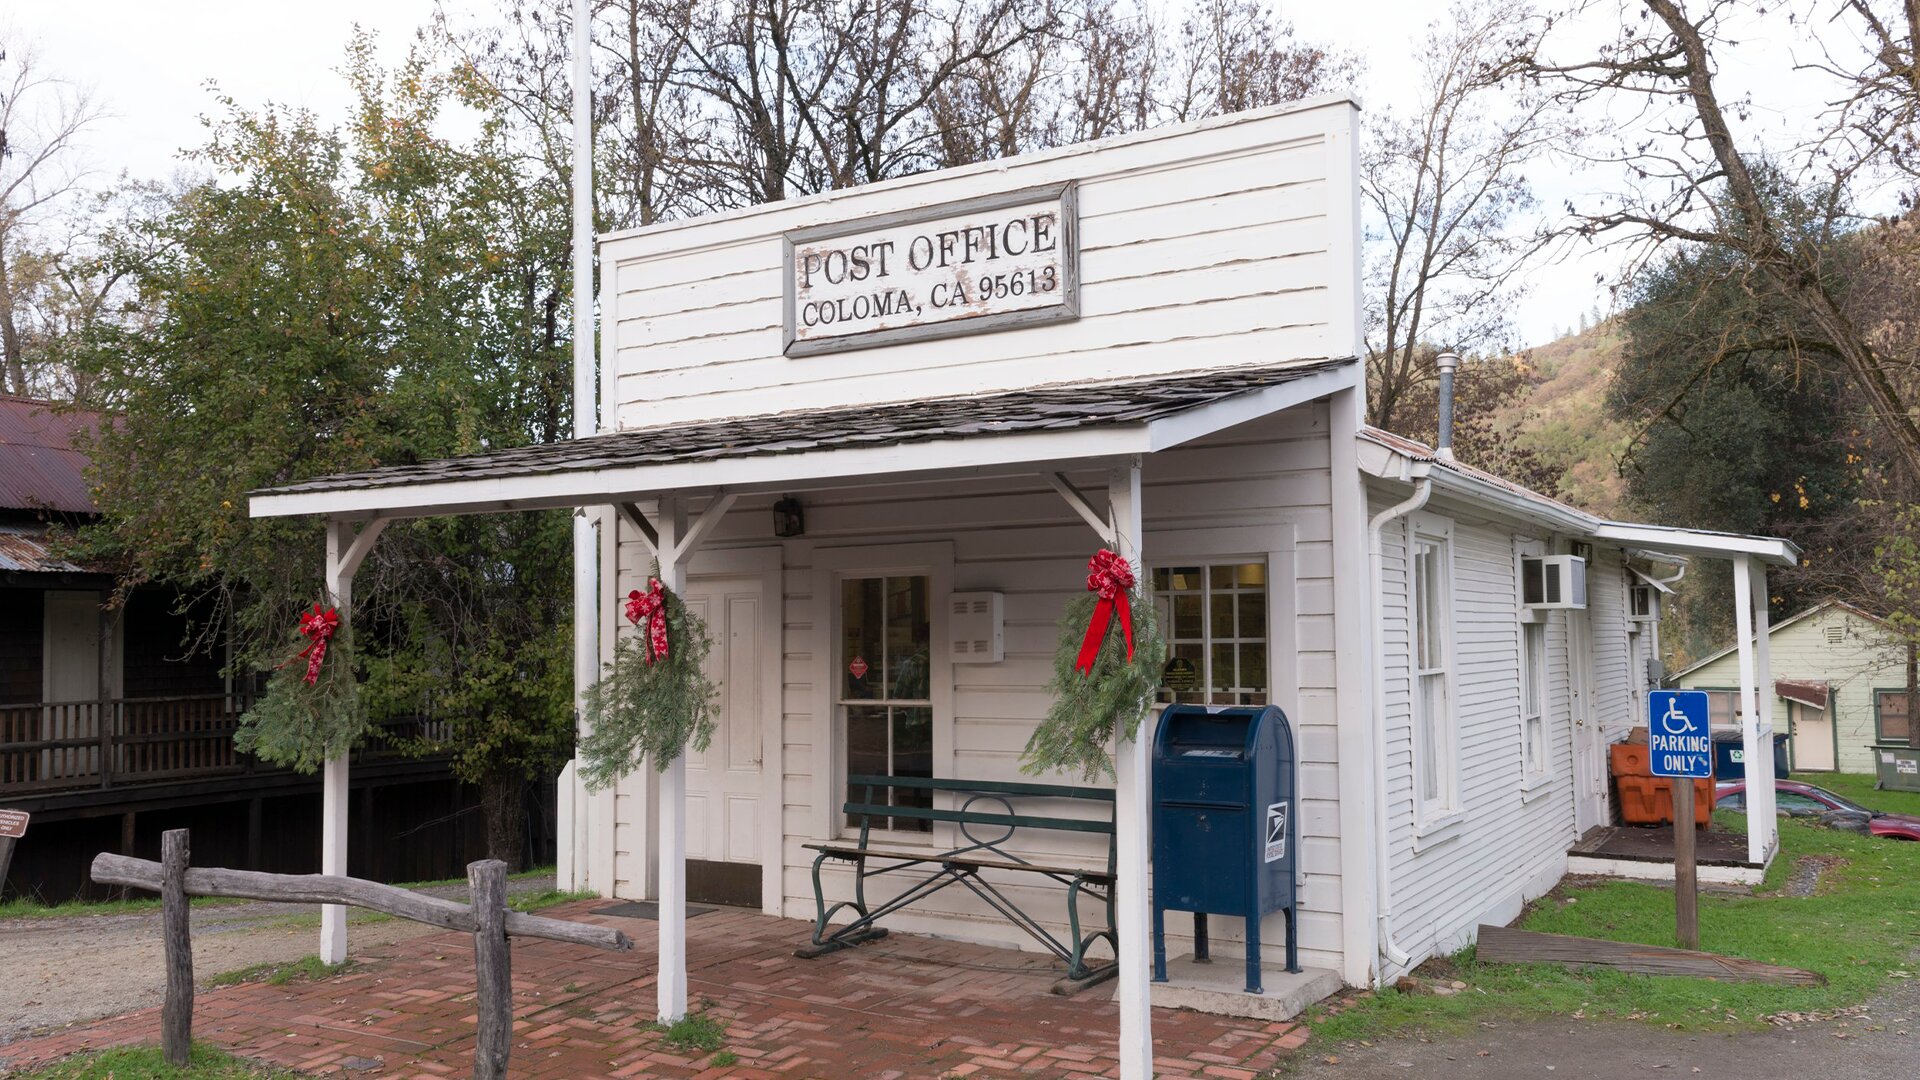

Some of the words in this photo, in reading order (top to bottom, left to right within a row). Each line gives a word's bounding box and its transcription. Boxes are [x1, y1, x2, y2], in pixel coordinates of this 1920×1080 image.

[801, 241, 894, 289] POST
[908, 213, 1057, 272] OFFICE
[802, 289, 922, 327] COLOMA,
[930, 282, 970, 308] CA
[978, 266, 1057, 302] 95613
[1652, 734, 1708, 753] PARKING
[1663, 754, 1697, 772] ONLY
